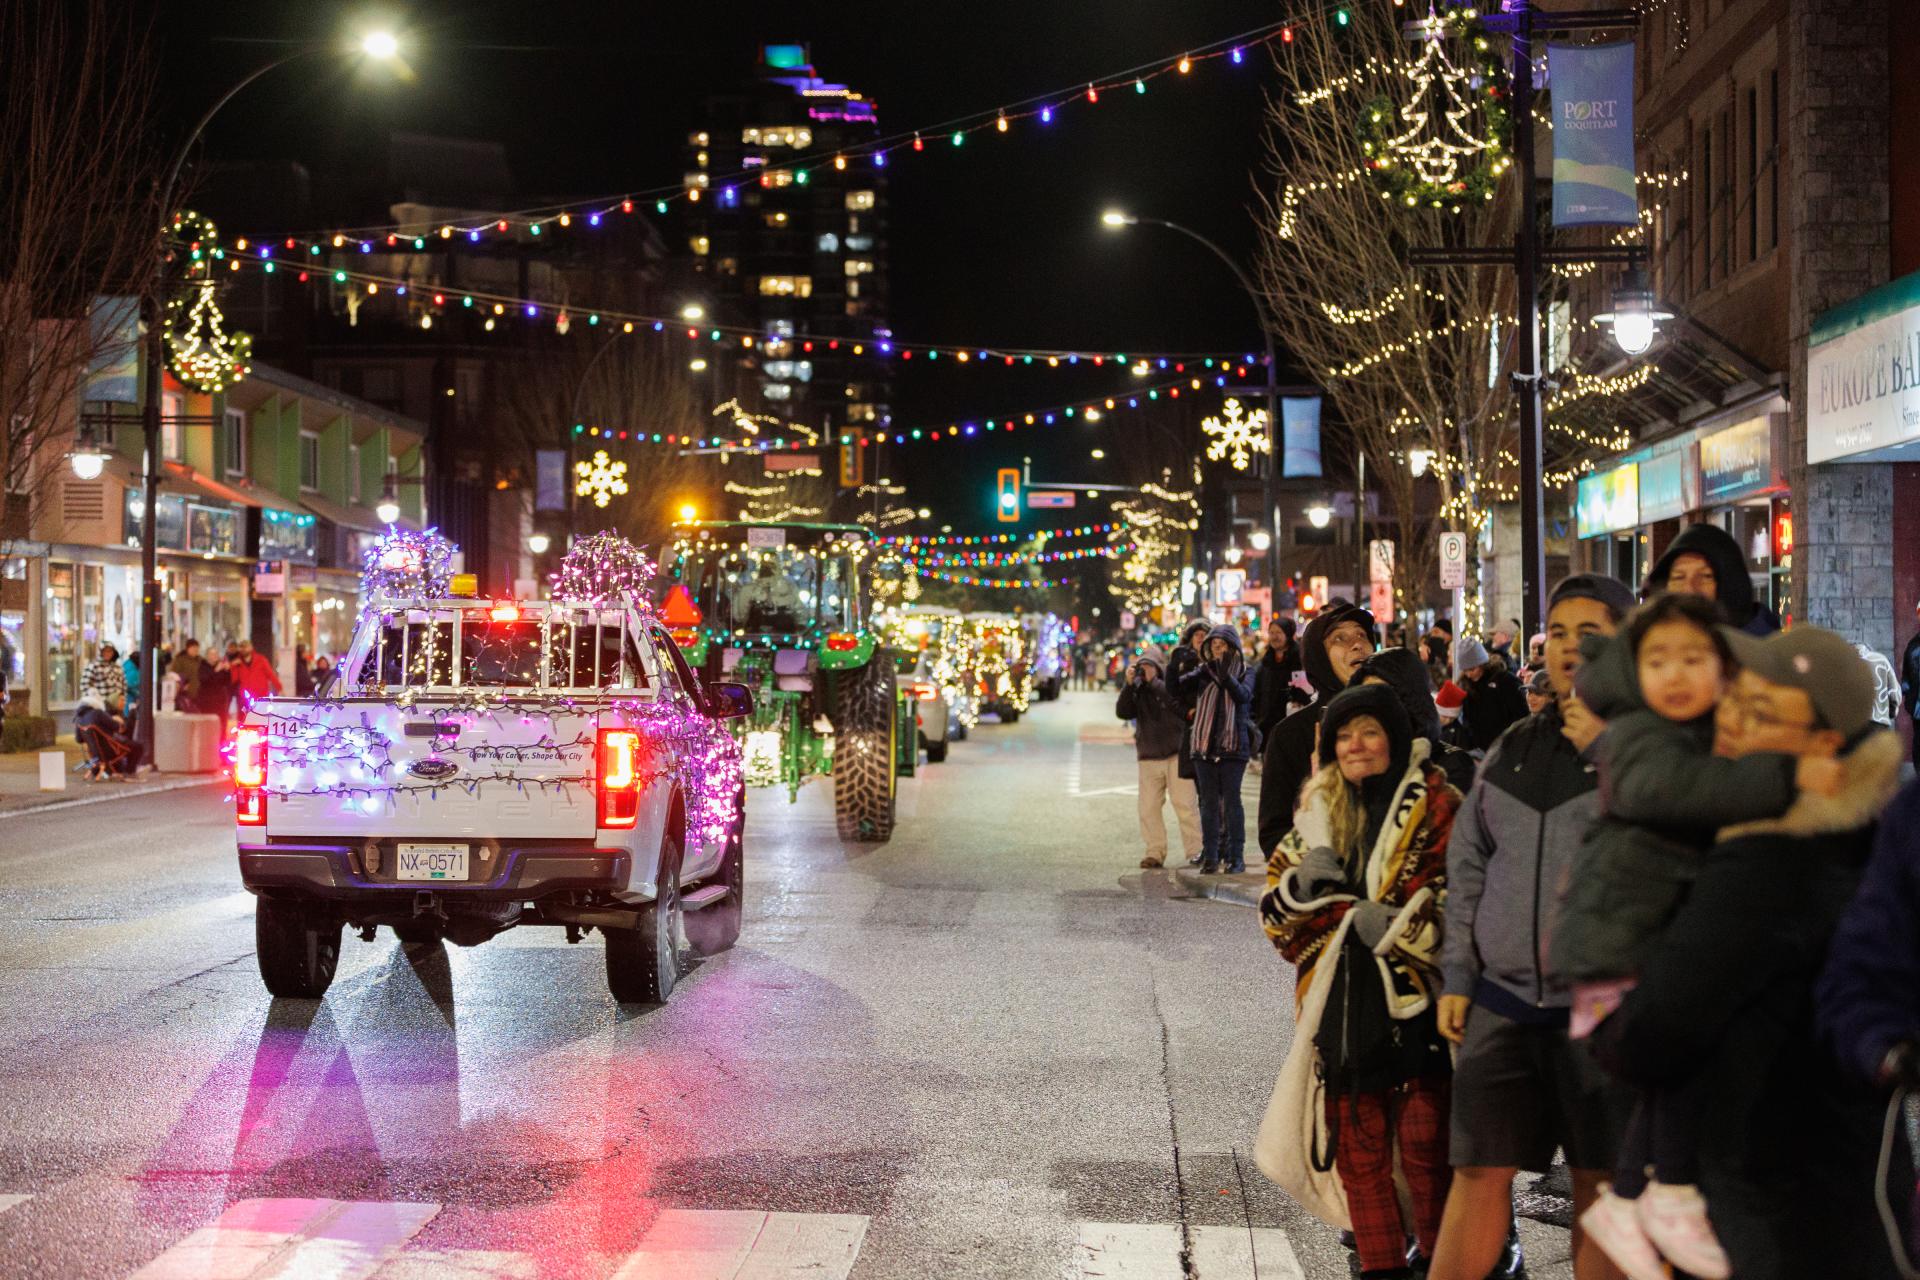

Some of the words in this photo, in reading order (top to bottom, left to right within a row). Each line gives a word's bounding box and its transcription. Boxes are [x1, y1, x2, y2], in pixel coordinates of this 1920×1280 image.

[1564, 101, 1617, 120] PORT
[1564, 120, 1617, 130] COQUITLAM
[1820, 344, 1887, 415] EUROPE
[1449, 543, 1457, 555] P
[531, 752, 554, 761] Shape
[568, 752, 583, 761] City
